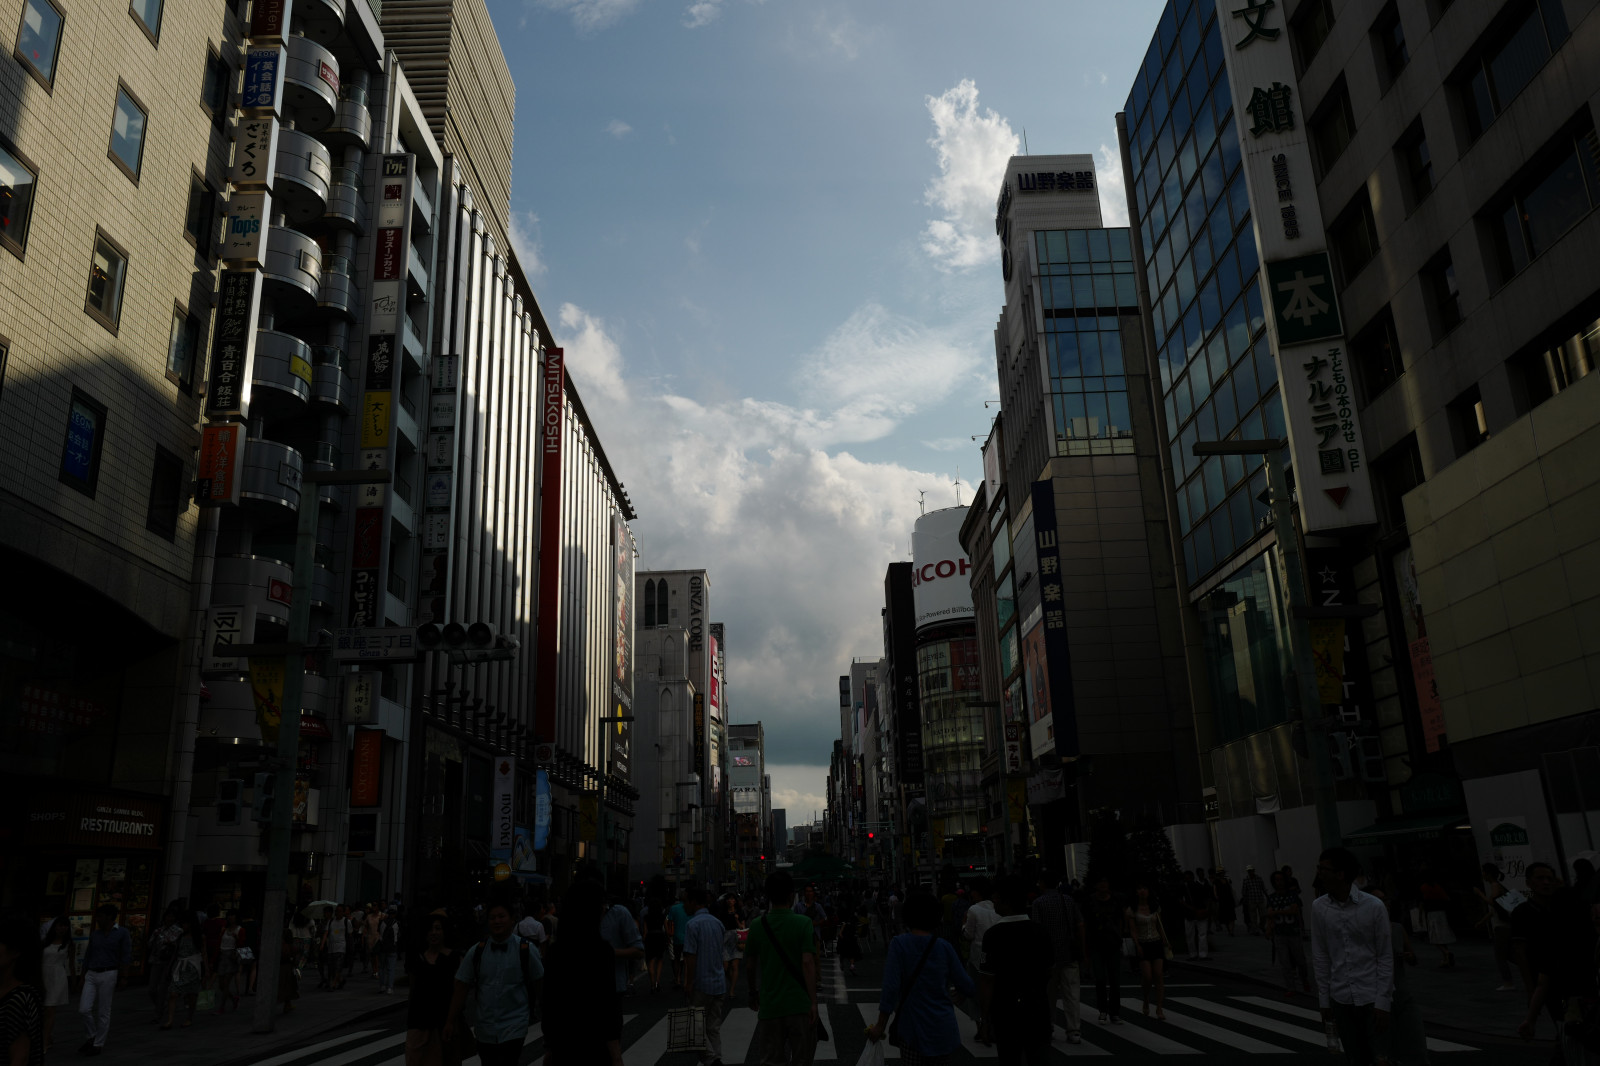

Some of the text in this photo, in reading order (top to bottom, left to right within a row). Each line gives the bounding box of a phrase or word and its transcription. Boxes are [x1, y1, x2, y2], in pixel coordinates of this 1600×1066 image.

[246, 61, 261, 105] イーオン
[260, 61, 275, 92] 英会話
[242, 123, 260, 177] ざくろ
[259, 123, 269, 150] 日本料理
[1017, 171, 1094, 191] 山野楽器
[1272, 153, 1301, 241] SINCE 1885
[383, 229, 396, 279] サッスーンカット
[1276, 269, 1332, 328] 本
[546, 354, 561, 455] MITSUKOSHI
[1328, 347, 1361, 473] 子どもの本のみせ 6F
[214, 430, 232, 497] 輸入洋食器
[1037, 530, 1065, 629] 山野楽器
[690, 576, 703, 652] GINZA CORE
[338, 635, 412, 650] 銀座三丁目
[359, 648, 390, 657] Ginza 3
[357, 735, 371, 800] L'OCCITANE
[30, 810, 66, 823] SHOPS
[80, 816, 155, 836] RESTAURANTS
[96, 805, 112, 814] GINZA
